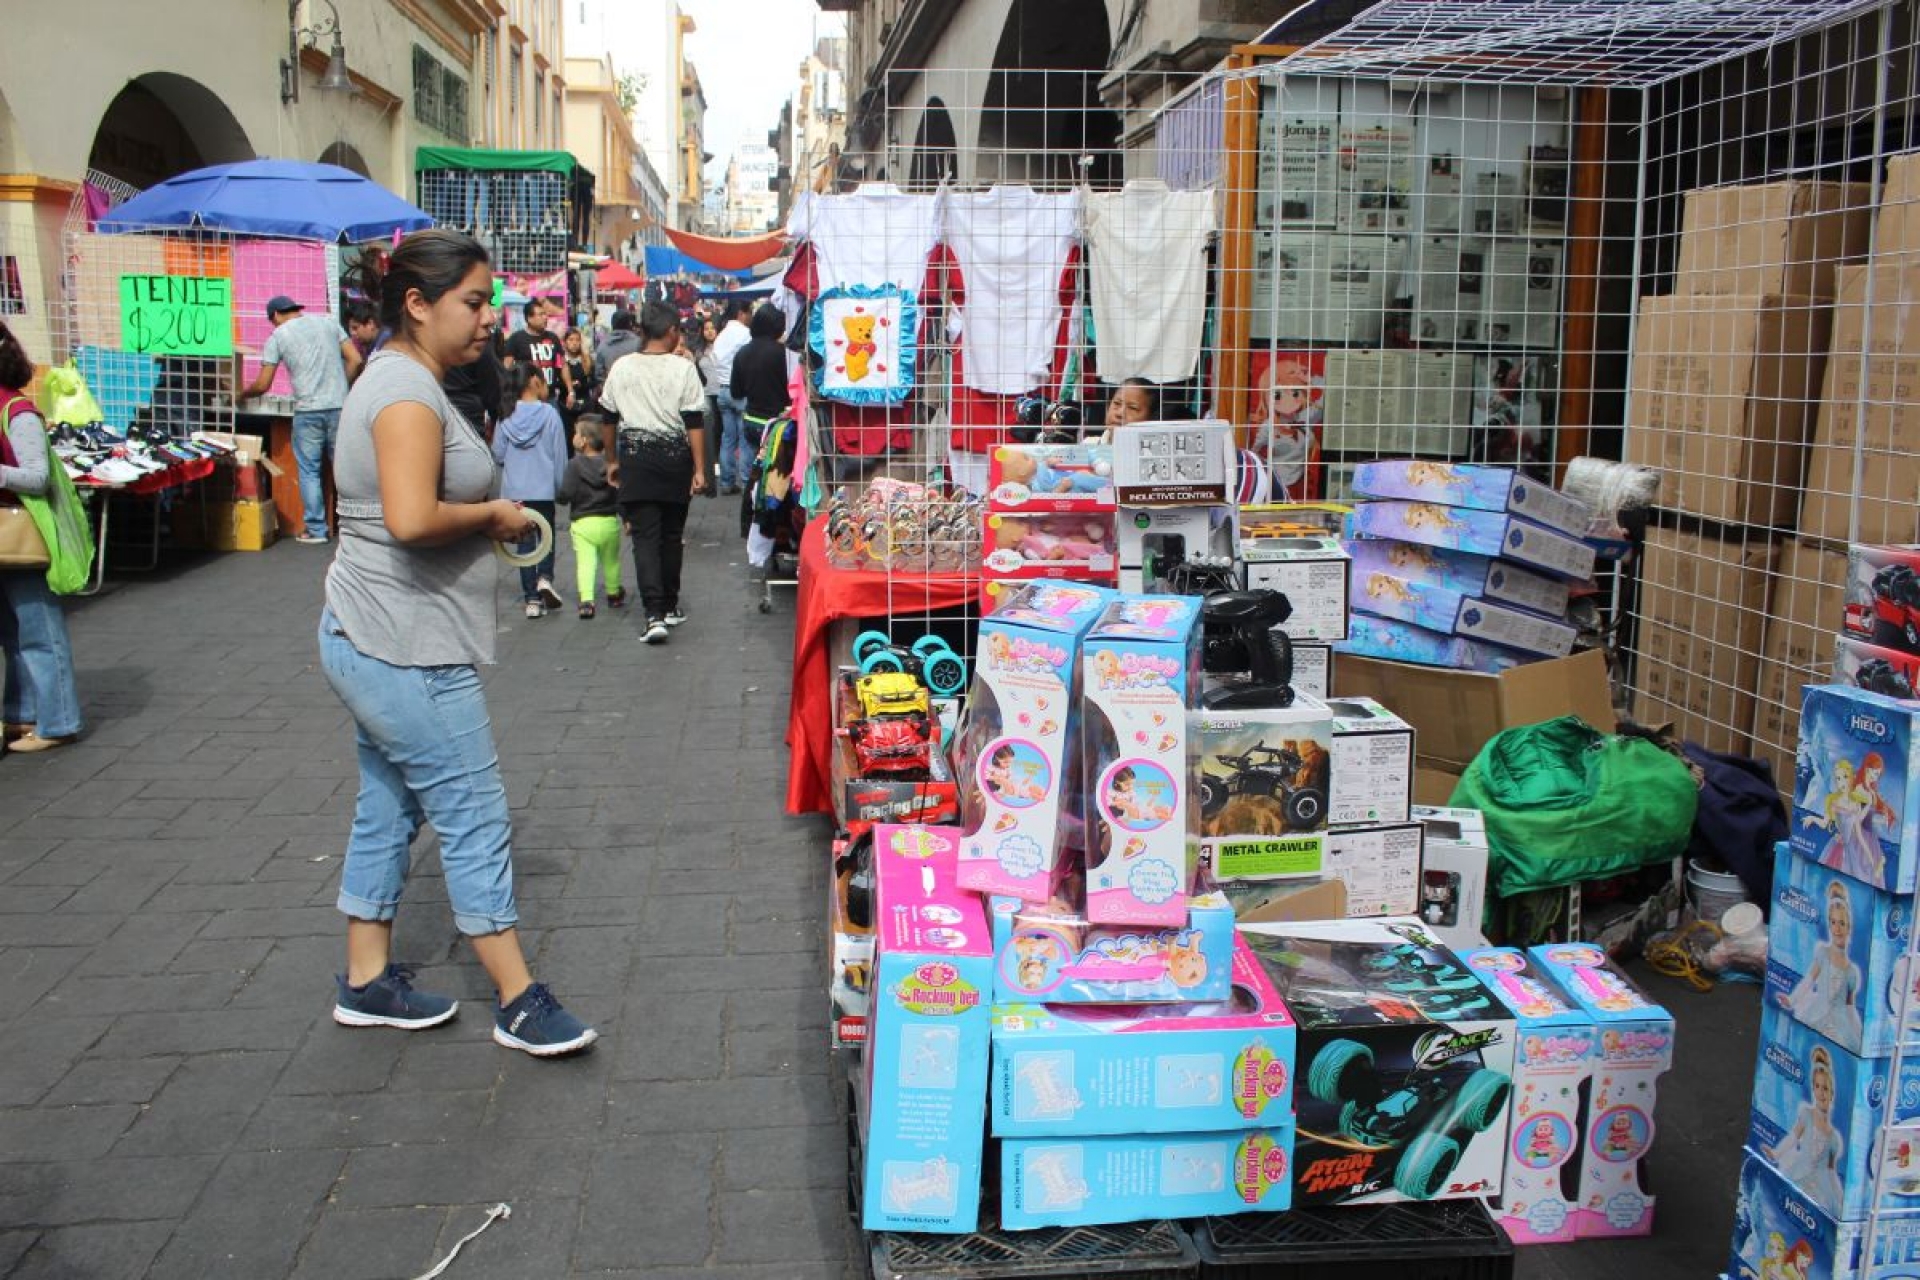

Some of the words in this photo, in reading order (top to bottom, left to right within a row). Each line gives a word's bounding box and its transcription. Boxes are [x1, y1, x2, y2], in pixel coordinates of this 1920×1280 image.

[121, 276, 225, 307] TENIS
[1129, 492, 1175, 501] INDUCTIVE
[1177, 491, 1217, 500] CONTROL
[1850, 714, 1886, 737] HIELO
[1222, 845, 1262, 857] METAL
[1265, 841, 1318, 854] CRAWLER
[912, 988, 955, 1007] Rocking
[960, 989, 980, 1006] bed
[1242, 1060, 1261, 1098] Rocking
[1243, 1101, 1259, 1119] bed
[1243, 1147, 1261, 1185] Rocking
[1299, 1153, 1375, 1184] ATOM
[1306, 1168, 1367, 1193] MAX
[1244, 1186, 1260, 1203] bed
[1784, 1196, 1817, 1230] HIELO
